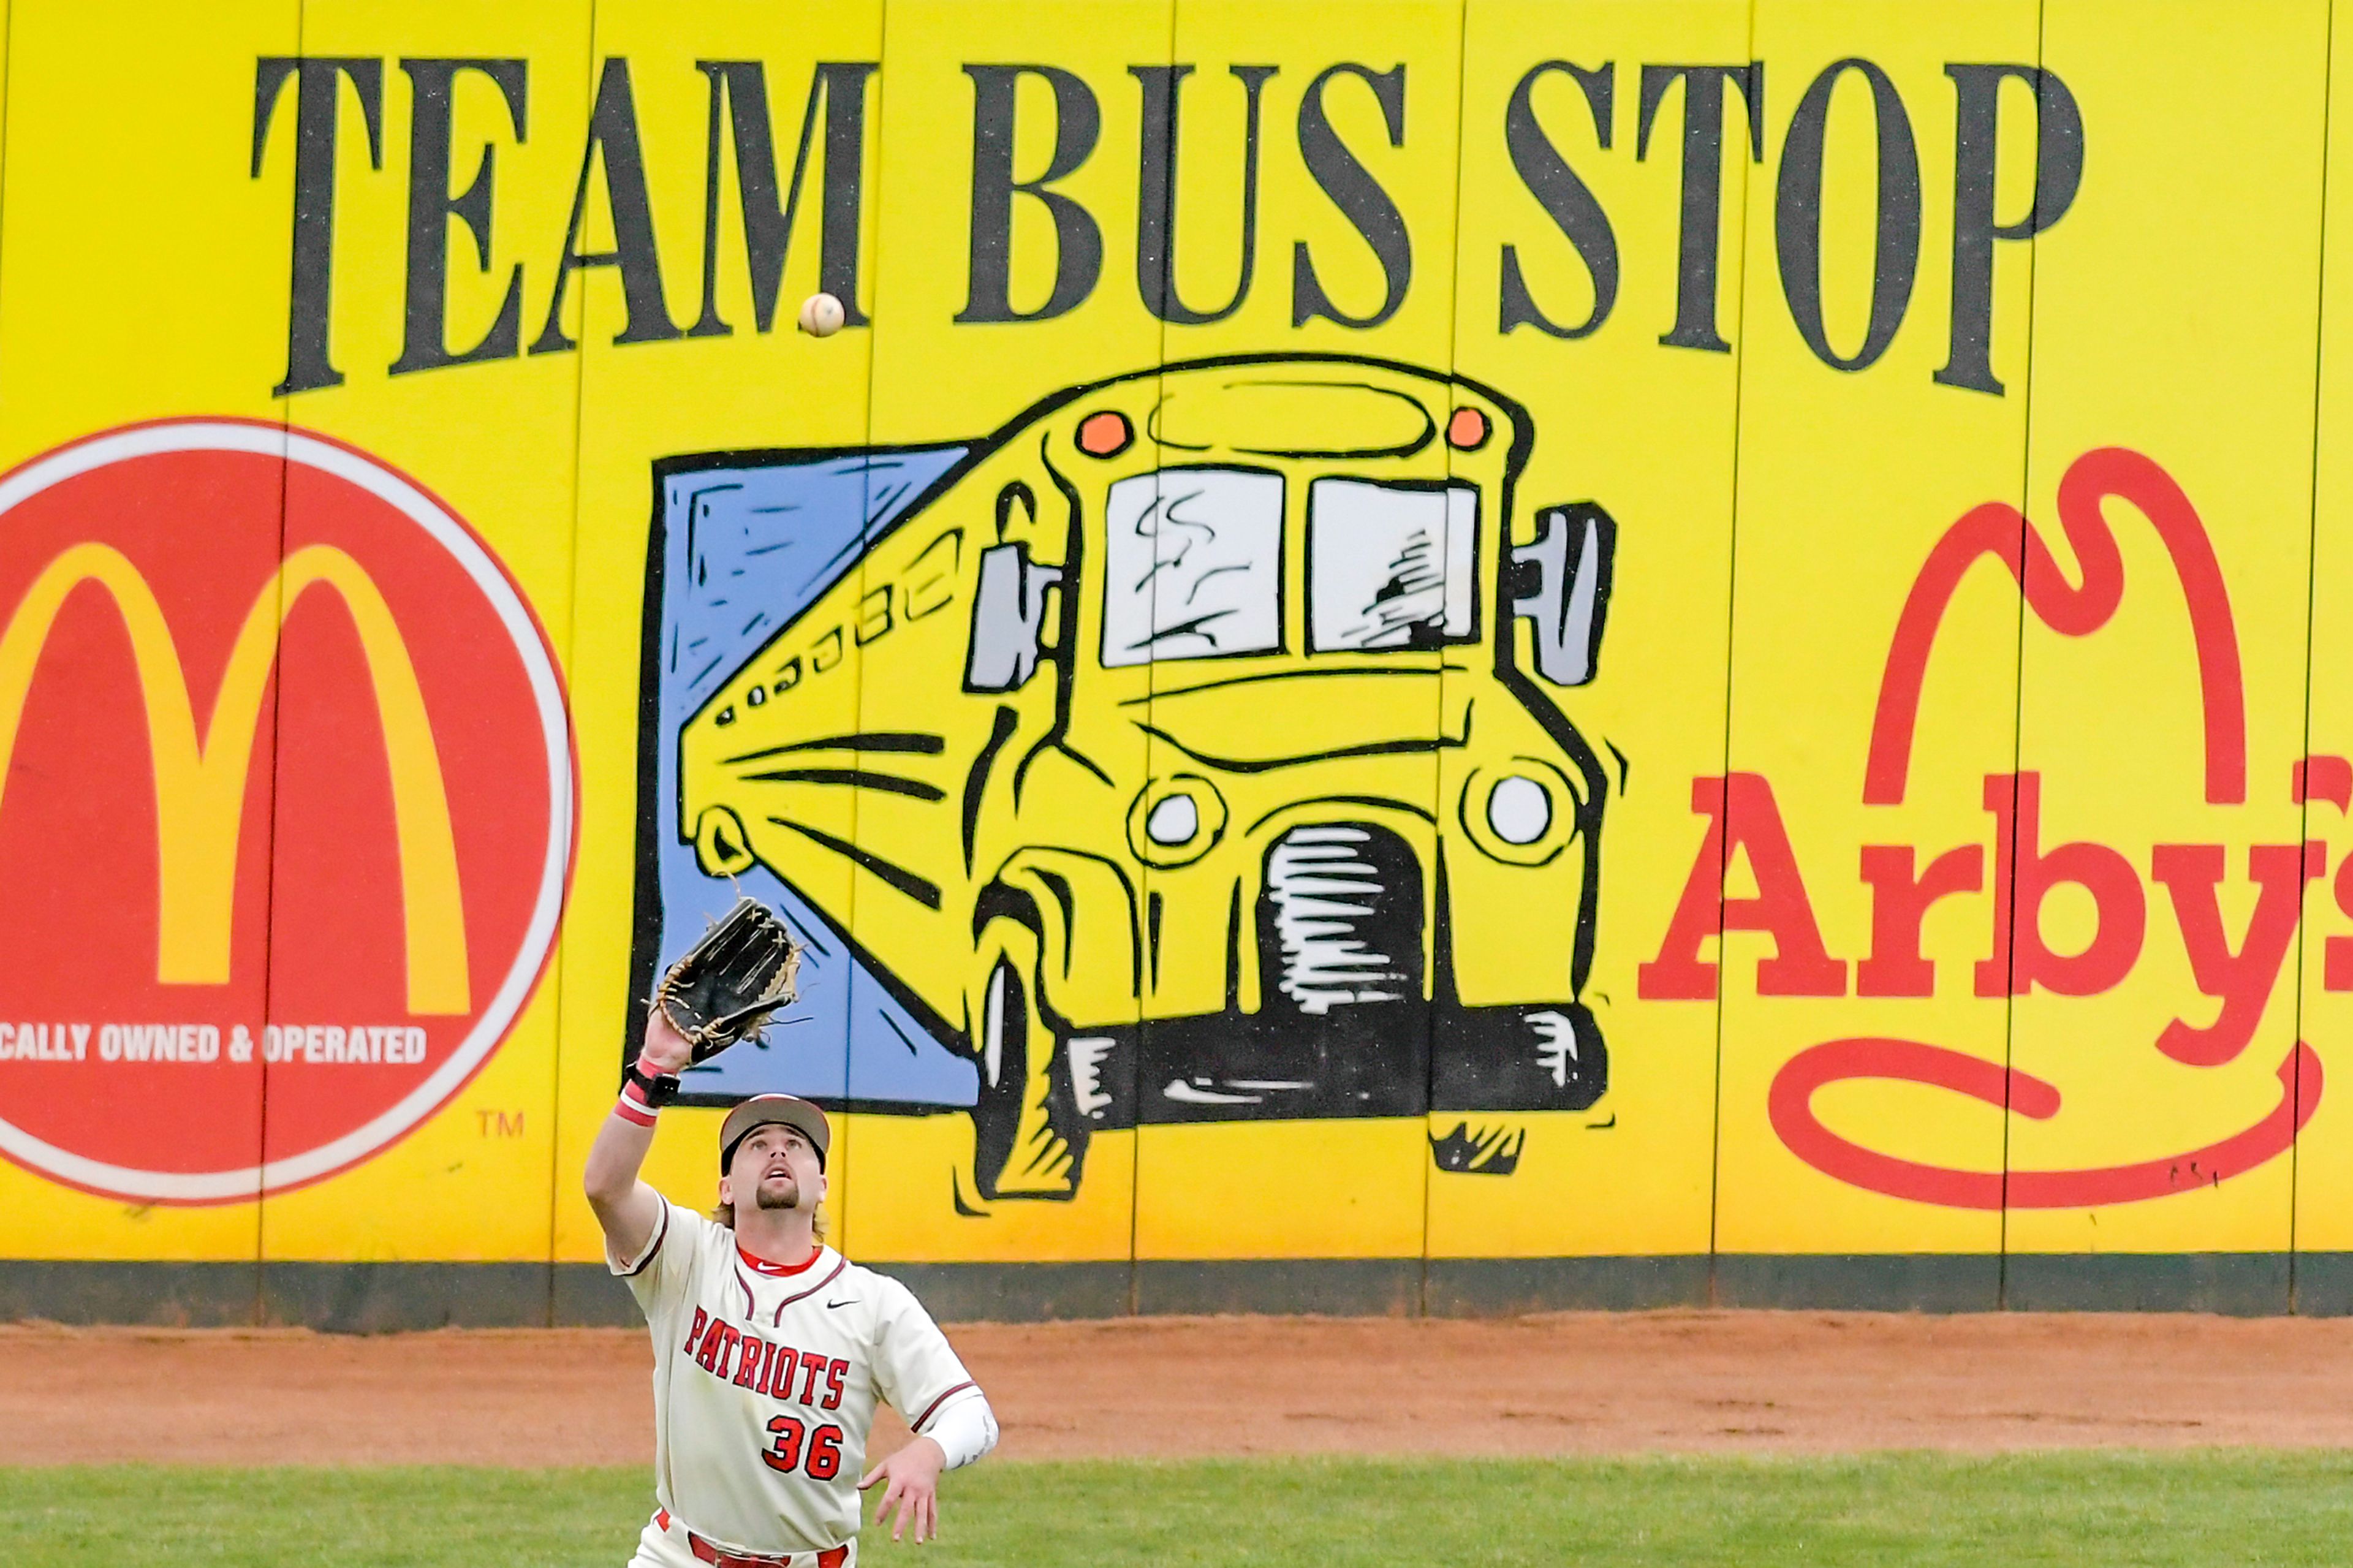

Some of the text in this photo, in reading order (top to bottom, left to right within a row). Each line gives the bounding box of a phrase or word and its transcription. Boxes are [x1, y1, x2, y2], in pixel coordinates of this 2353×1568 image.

[251, 56, 2084, 398] TEAM BUS STOP
[99, 1023, 219, 1062] OWNED
[229, 1024, 253, 1062] &
[263, 1025, 427, 1064] OPERATED
[476, 1111, 525, 1137] TM
[684, 1304, 850, 1410] PATRIOTS
[761, 1414, 844, 1482] 36
